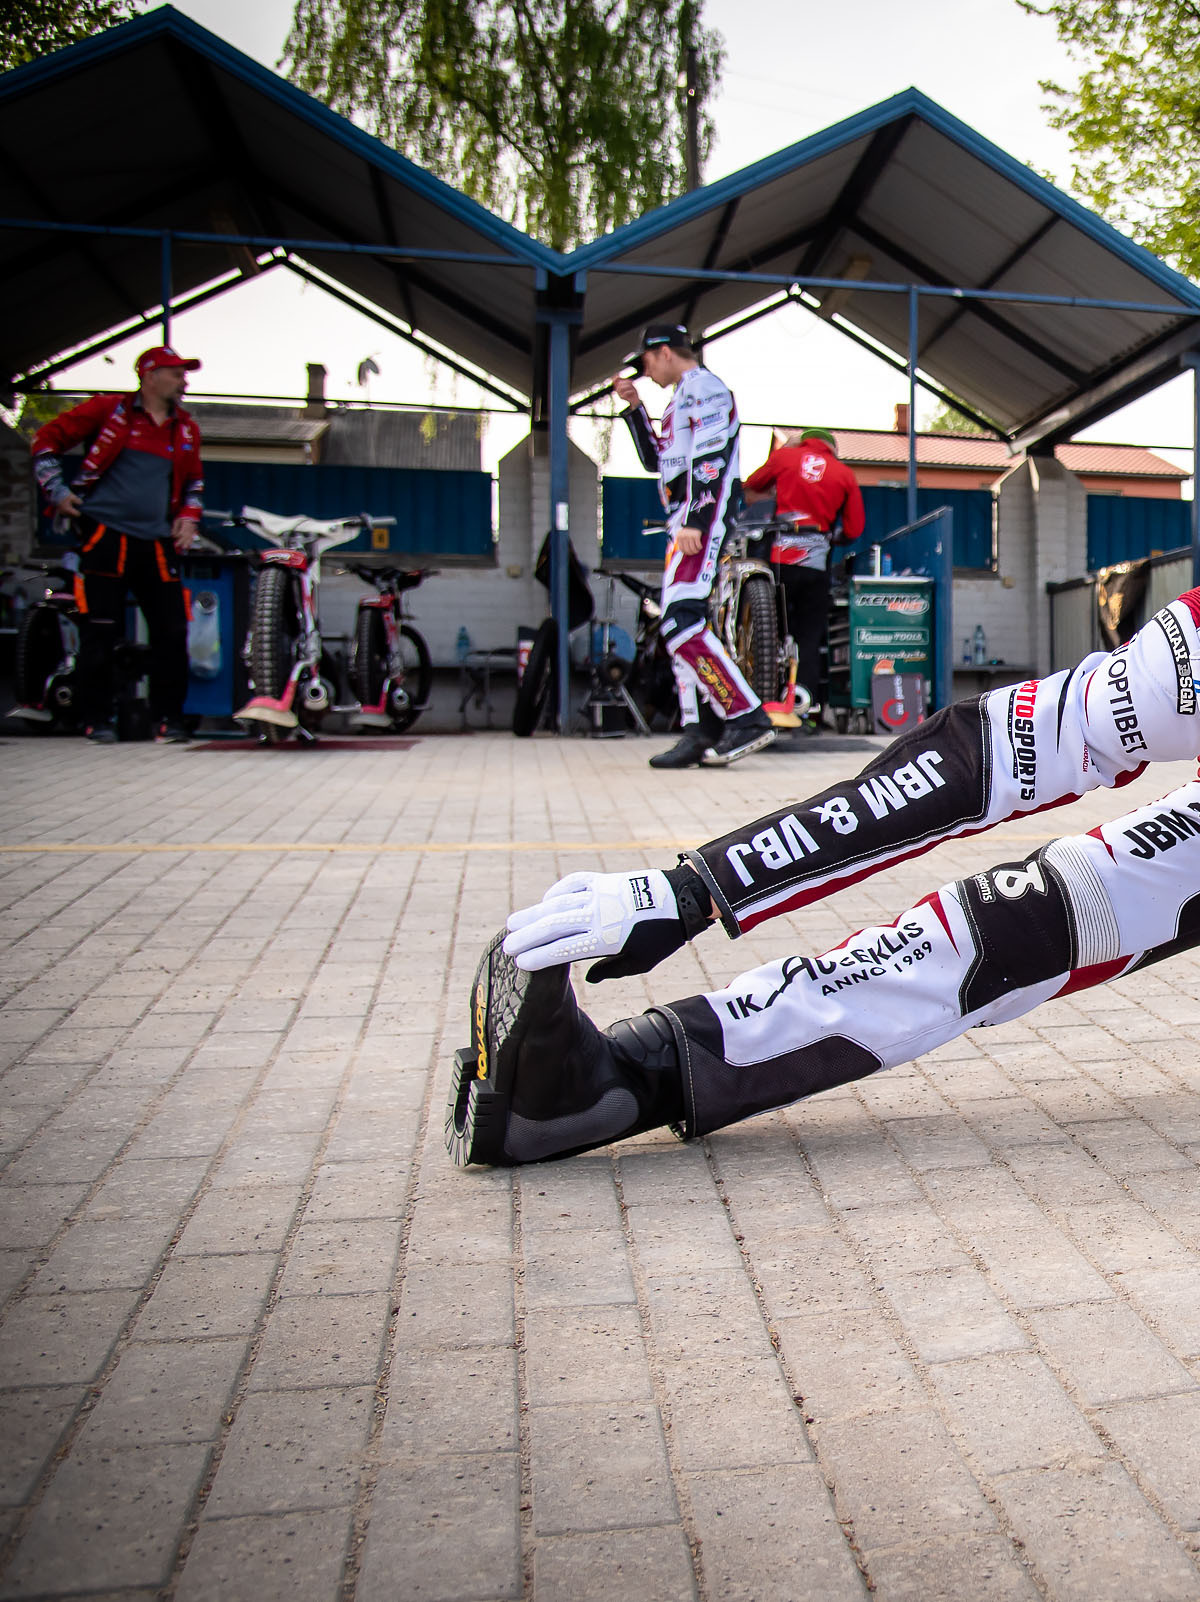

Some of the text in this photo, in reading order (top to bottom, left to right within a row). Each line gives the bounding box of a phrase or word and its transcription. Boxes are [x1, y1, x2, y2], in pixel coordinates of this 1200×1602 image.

[1108, 658, 1148, 754] OPTIBET
[725, 749, 947, 887] JBM & VBJ
[821, 941, 933, 996] ANNO 1989
[726, 994, 764, 1020] IK
